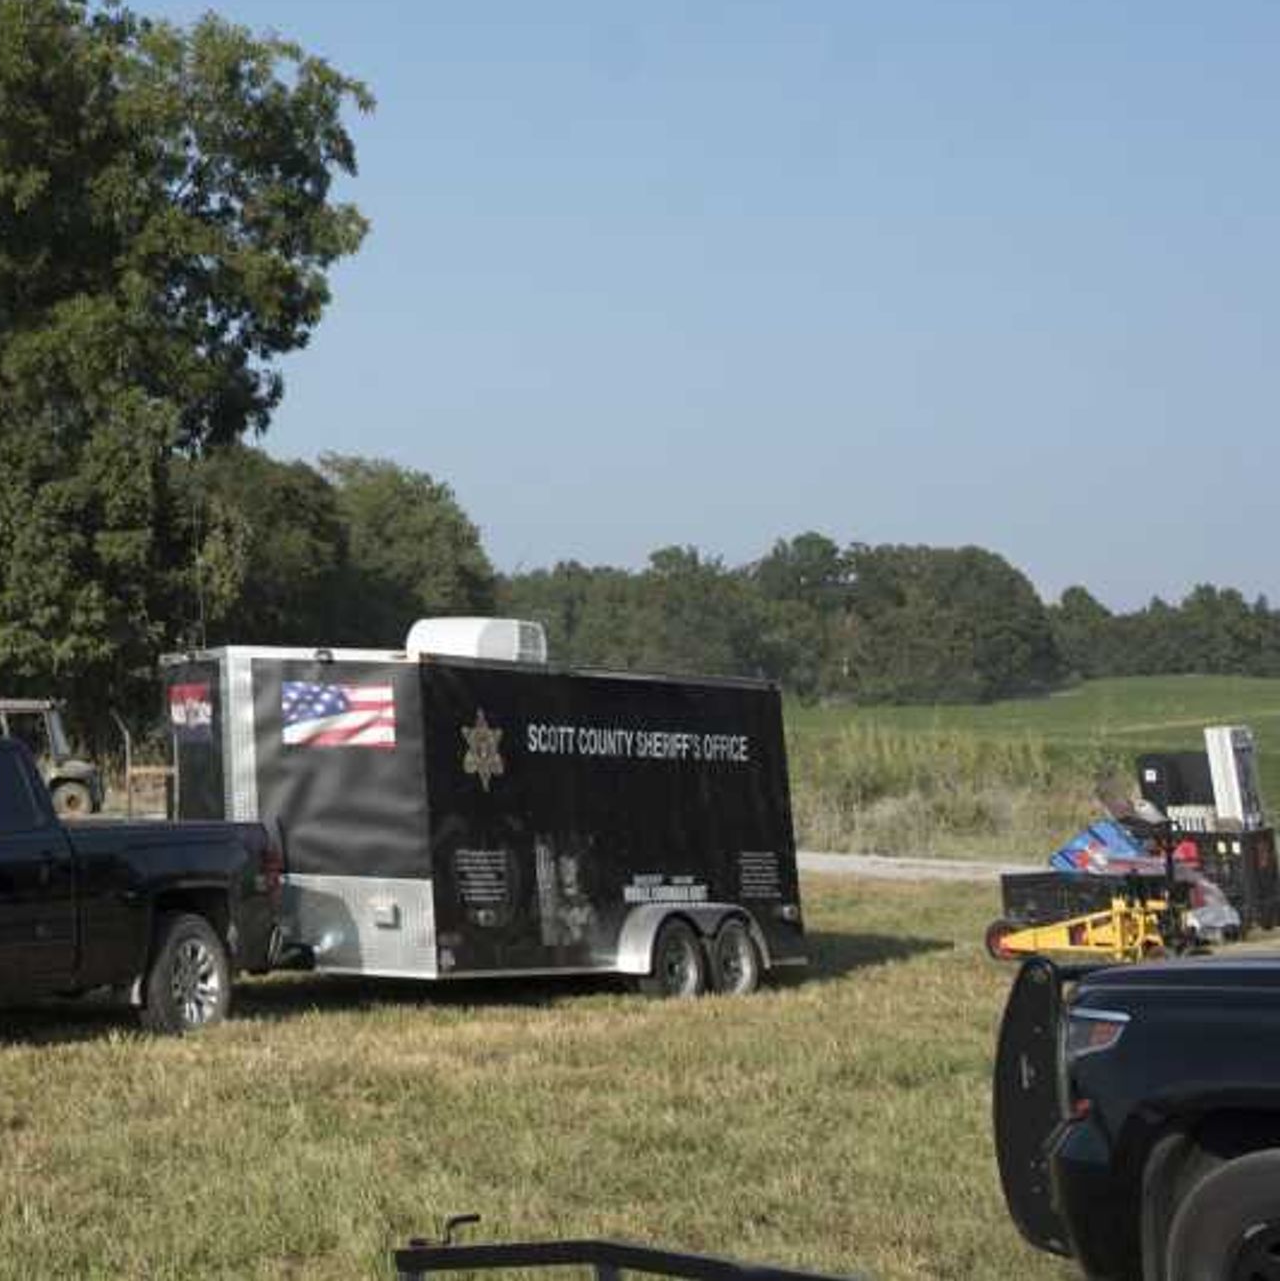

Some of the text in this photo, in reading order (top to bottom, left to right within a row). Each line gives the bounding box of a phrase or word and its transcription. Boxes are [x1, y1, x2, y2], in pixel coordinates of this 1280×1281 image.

[527, 724, 749, 761] SCOTT COUNTY SHERIFF'S OFFICE
